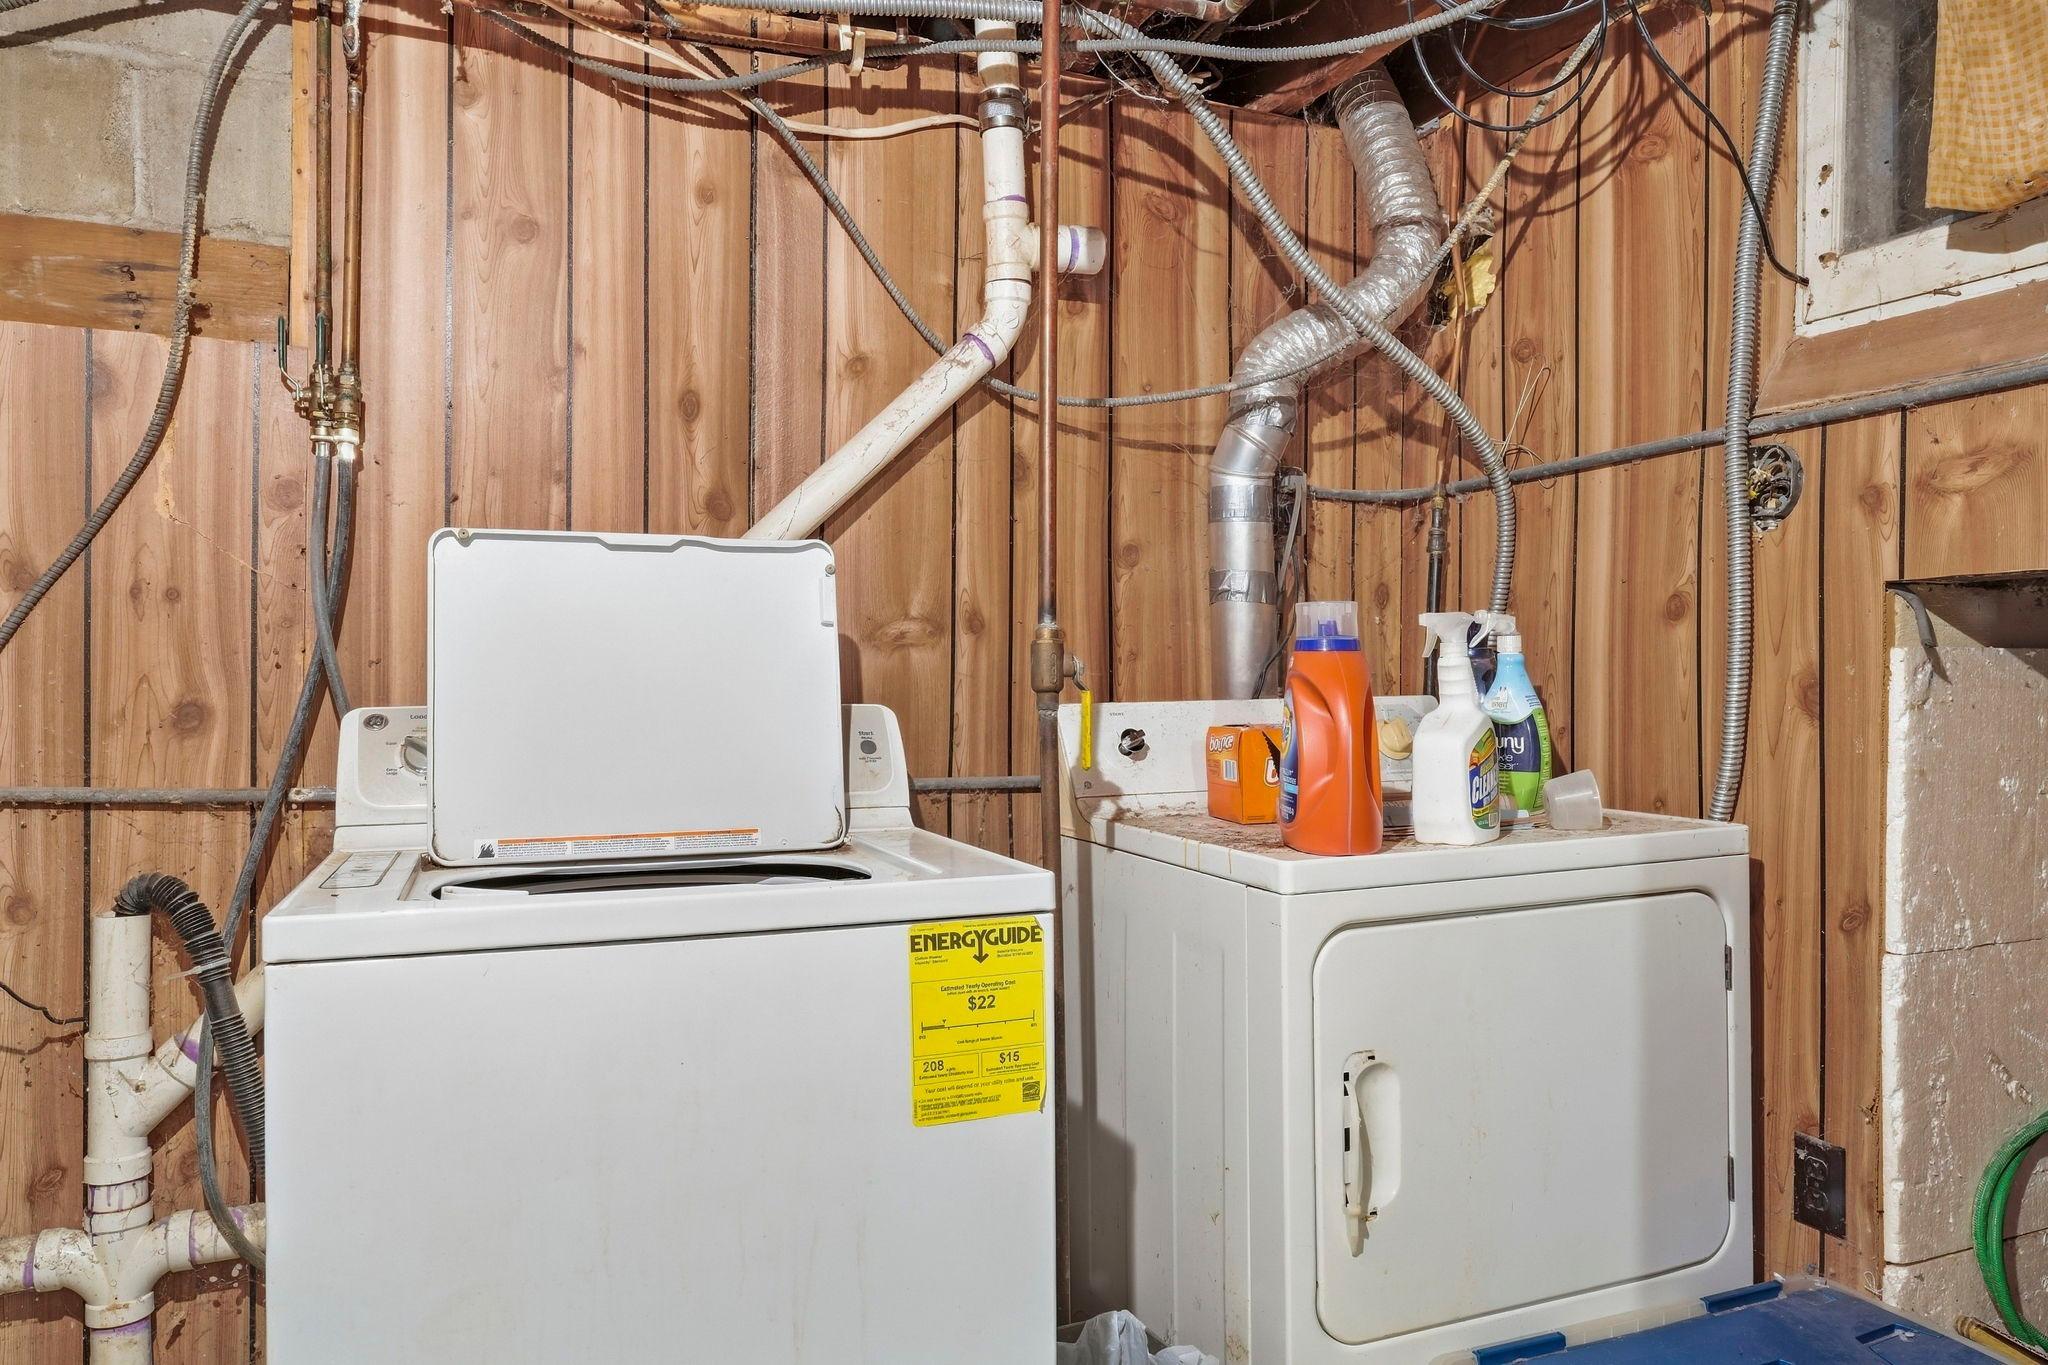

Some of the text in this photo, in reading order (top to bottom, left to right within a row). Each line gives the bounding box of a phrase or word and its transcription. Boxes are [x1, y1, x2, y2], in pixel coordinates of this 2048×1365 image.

[910, 925, 1042, 953] ENERGYGUIDE
[968, 995, 996, 1012] $22
[999, 1051, 1020, 1064] $15
[923, 1060, 944, 1073] 208
